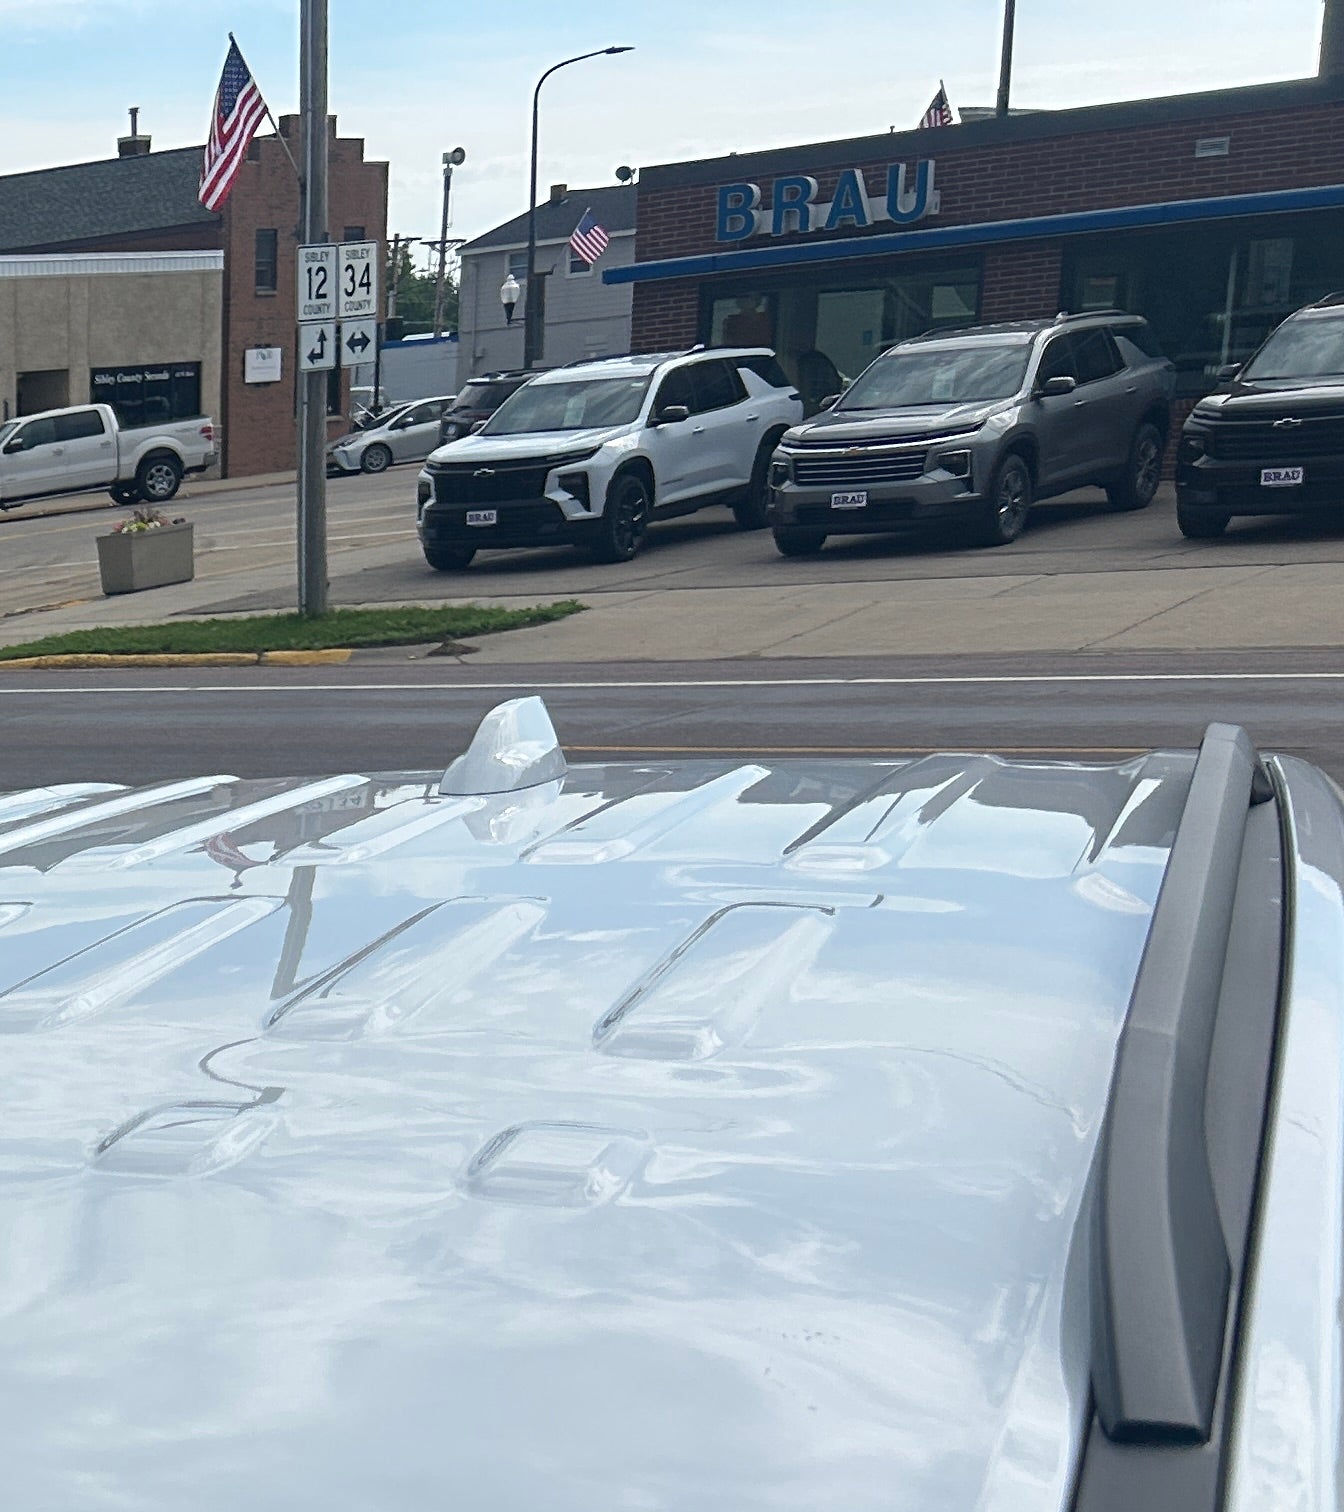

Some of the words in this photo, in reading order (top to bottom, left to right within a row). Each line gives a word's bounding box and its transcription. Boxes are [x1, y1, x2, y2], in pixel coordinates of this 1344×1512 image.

[715, 160, 933, 242] BRAU
[305, 251, 330, 263] SIBLEY
[345, 248, 370, 260] SIBLEY
[307, 266, 328, 300] 12
[344, 262, 372, 297] 34
[303, 303, 331, 315] COUNTY
[344, 299, 372, 312] COUNTY
[1264, 470, 1301, 482] BRAU
